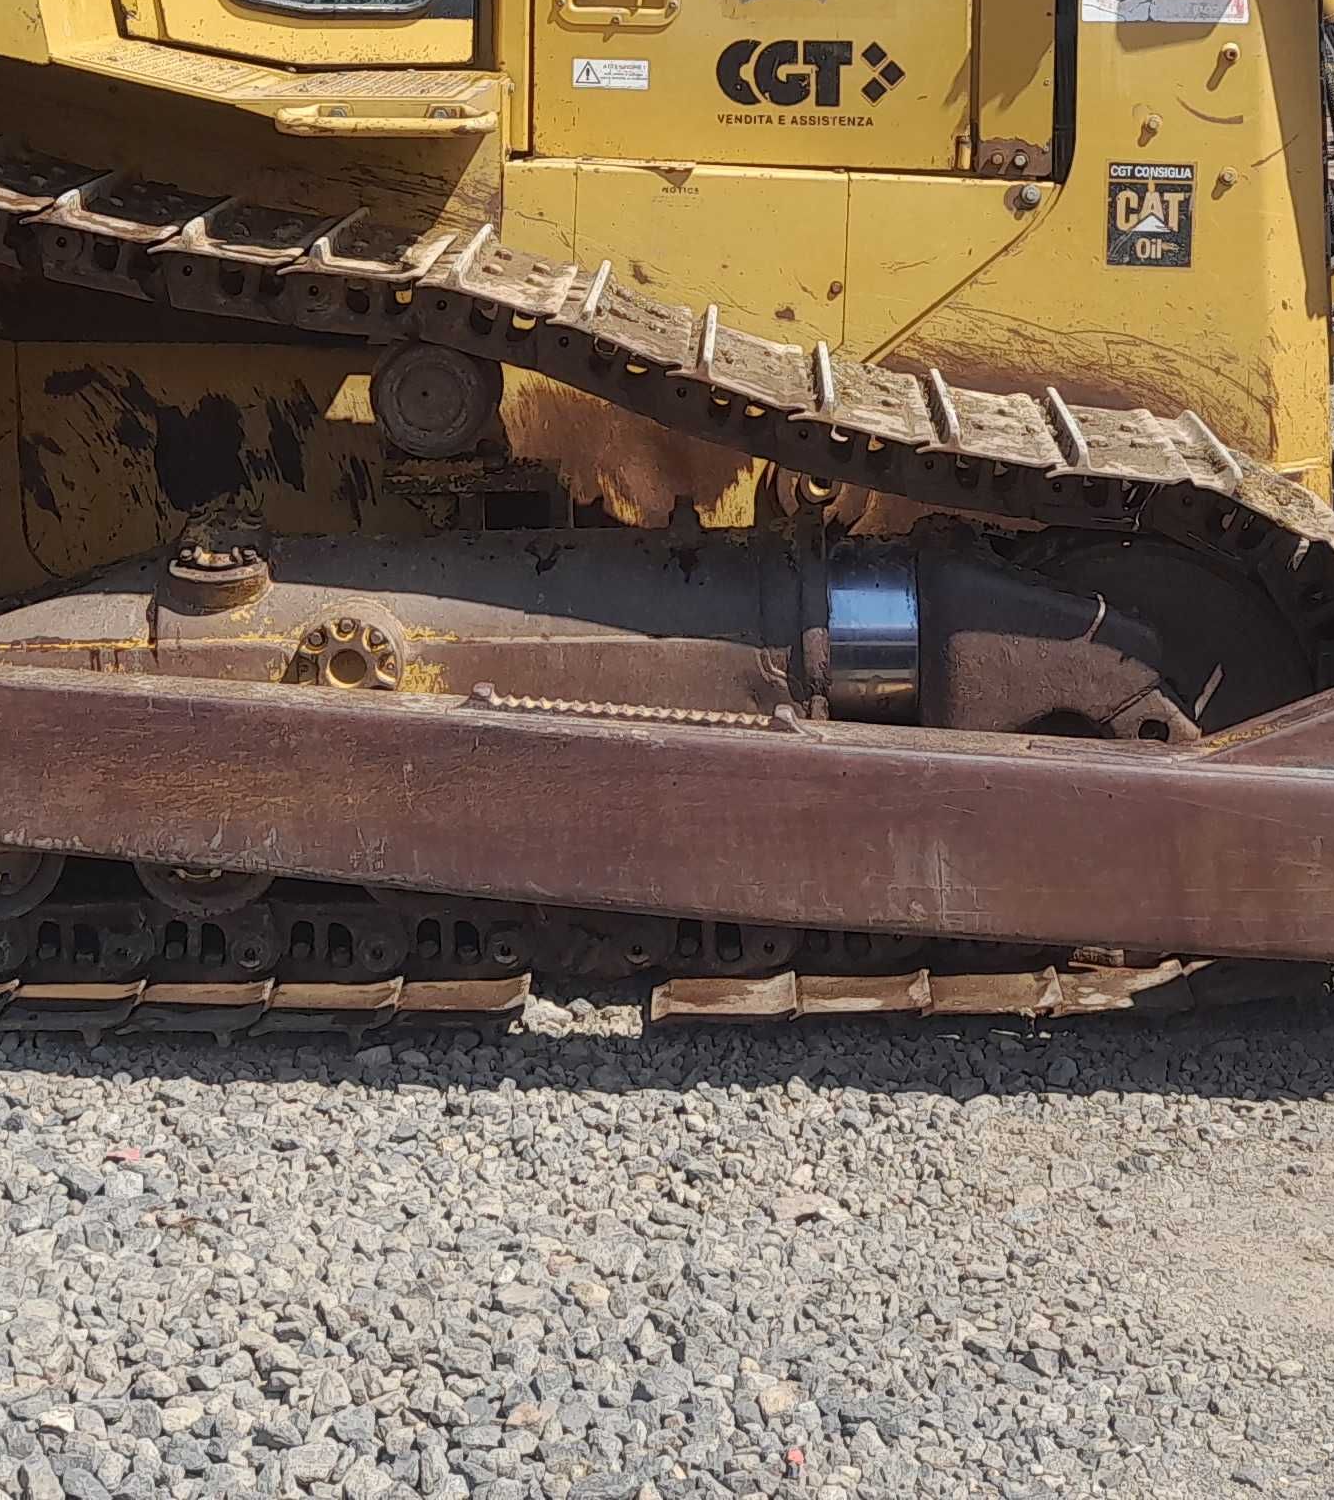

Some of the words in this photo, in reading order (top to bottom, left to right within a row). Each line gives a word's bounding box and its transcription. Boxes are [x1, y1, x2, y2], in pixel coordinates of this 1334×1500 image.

[716, 40, 853, 106] CGT
[717, 114, 773, 125] VENDITA
[778, 114, 786, 125] E
[790, 115, 874, 127] ASSISTENZA
[1111, 165, 1133, 177] CGT
[1135, 167, 1192, 179] CONSIGLIA
[1115, 188, 1185, 233] CAT
[1135, 238, 1163, 259] Oil
